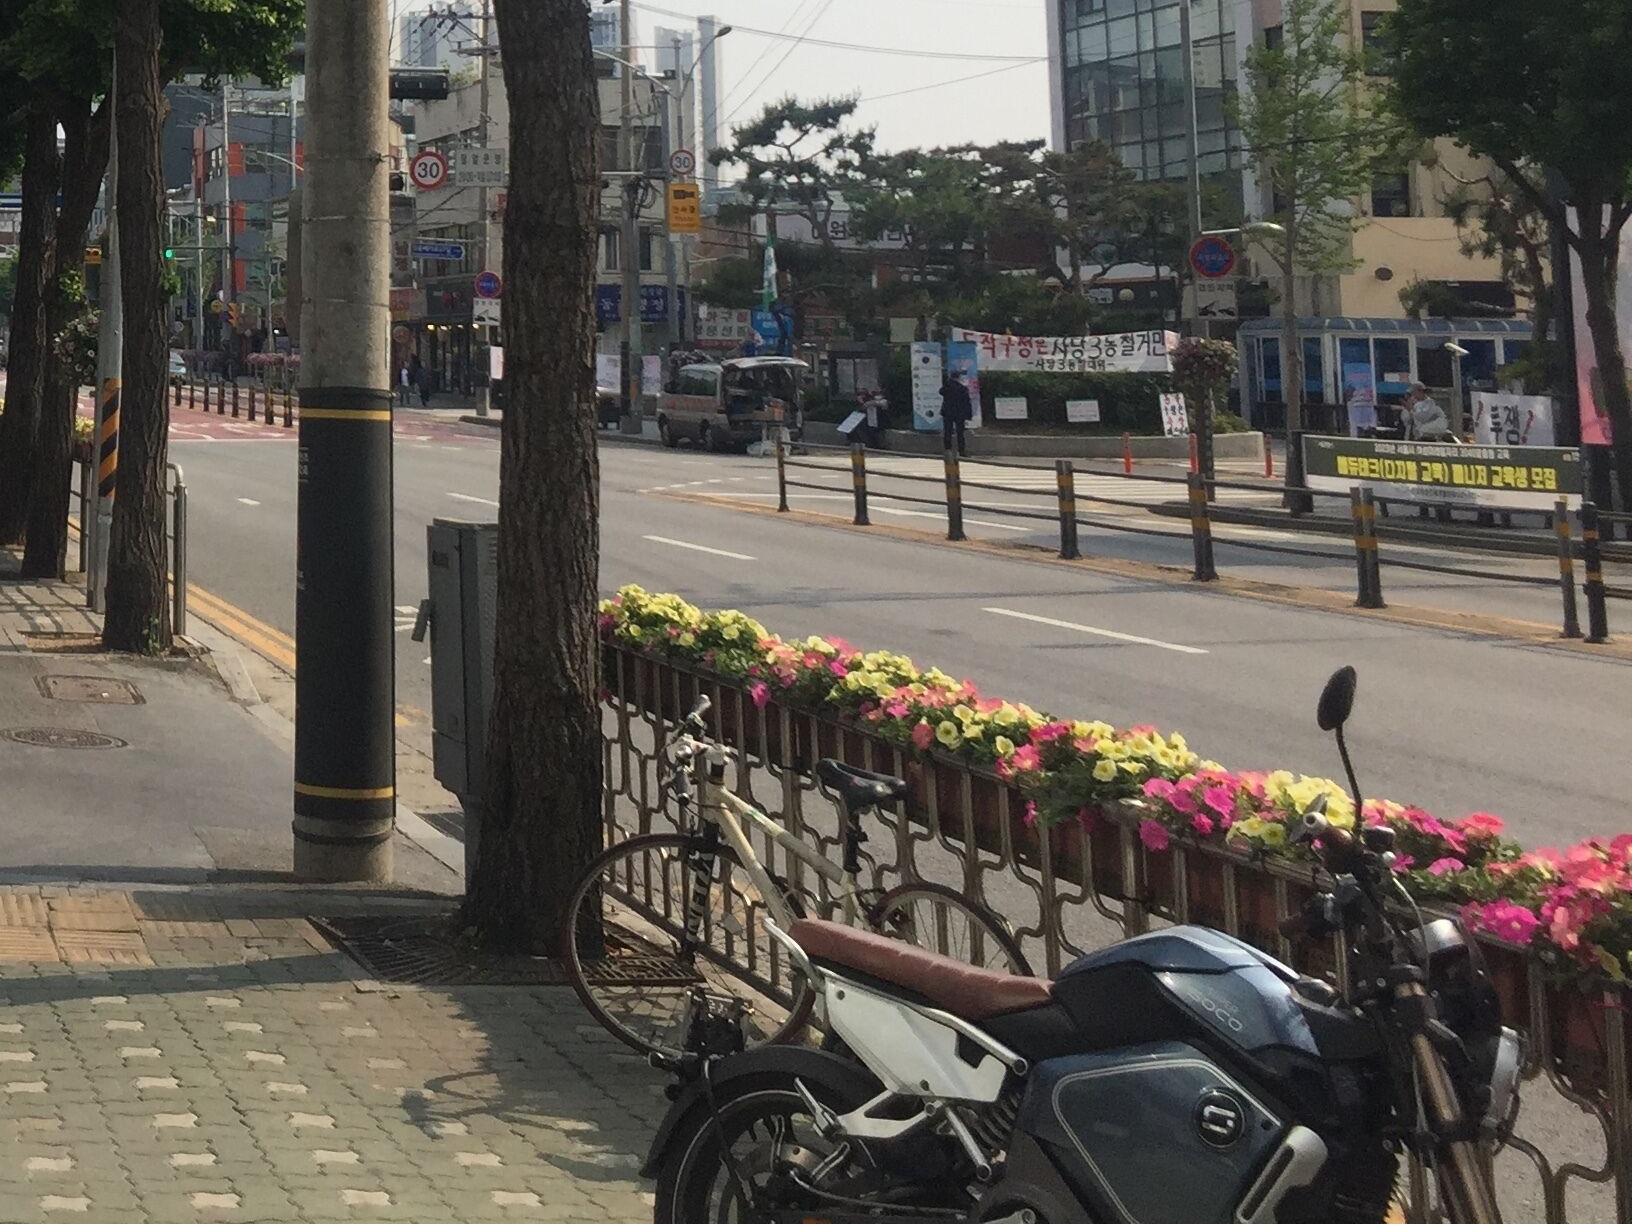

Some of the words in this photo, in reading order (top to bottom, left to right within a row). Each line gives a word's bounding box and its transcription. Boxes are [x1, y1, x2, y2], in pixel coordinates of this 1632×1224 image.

[417, 161, 440, 179] 30
[674, 156, 691, 168] 30
[1491, 465, 1527, 488] 교육생
[1531, 468, 1557, 490] 모집
